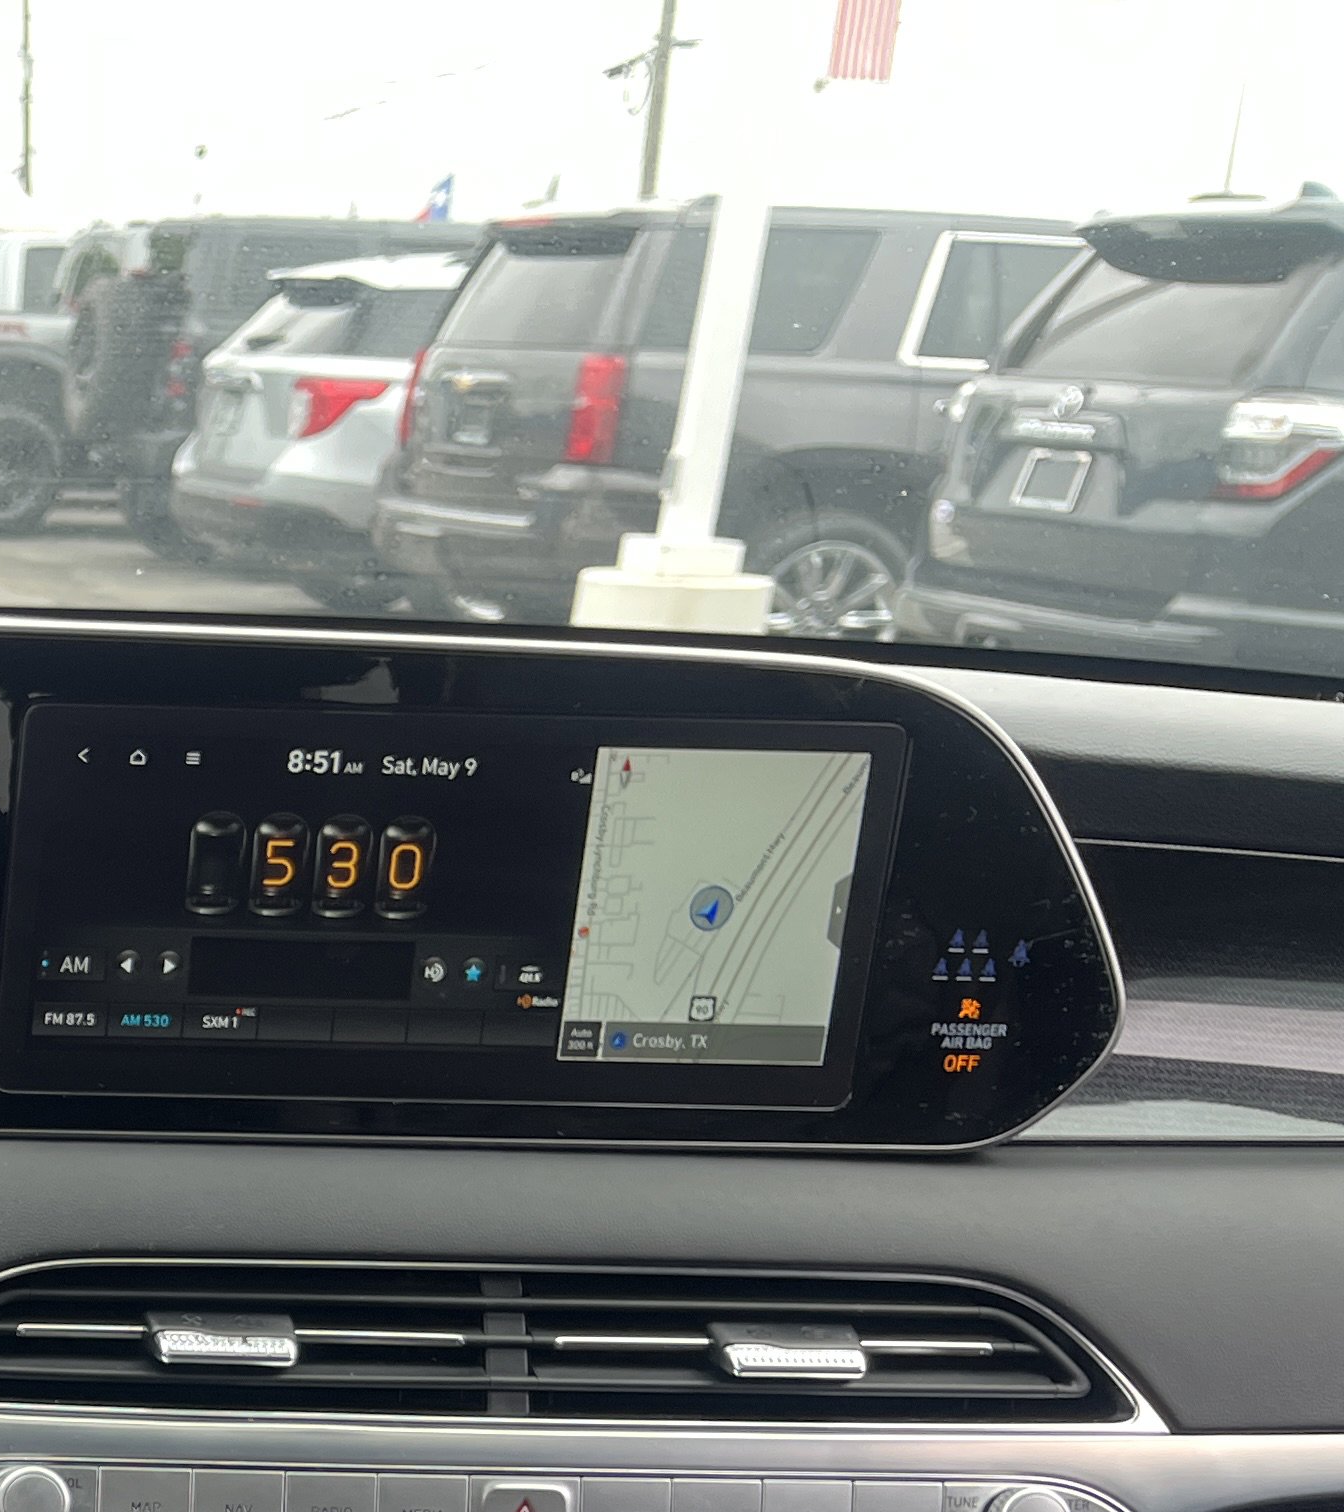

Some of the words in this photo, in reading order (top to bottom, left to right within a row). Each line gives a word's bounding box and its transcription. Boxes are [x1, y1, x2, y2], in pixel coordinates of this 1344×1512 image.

[287, 749, 341, 775] 8:51
[343, 762, 364, 774] AM
[421, 757, 461, 781] May
[465, 758, 479, 778] 9
[59, 955, 91, 975] AM
[43, 1012, 64, 1026] FM
[66, 1012, 96, 1027] 87.5
[120, 1013, 141, 1027] AM
[143, 1013, 169, 1028] 530
[202, 1014, 230, 1029] SXM
[930, 1022, 1008, 1037] PASSENGER
[690, 1034, 709, 1049] TX
[940, 1036, 963, 1049] AIR
[965, 1037, 993, 1050] BAG
[943, 1054, 982, 1073] OFF
[947, 1495, 979, 1508] TUNE
